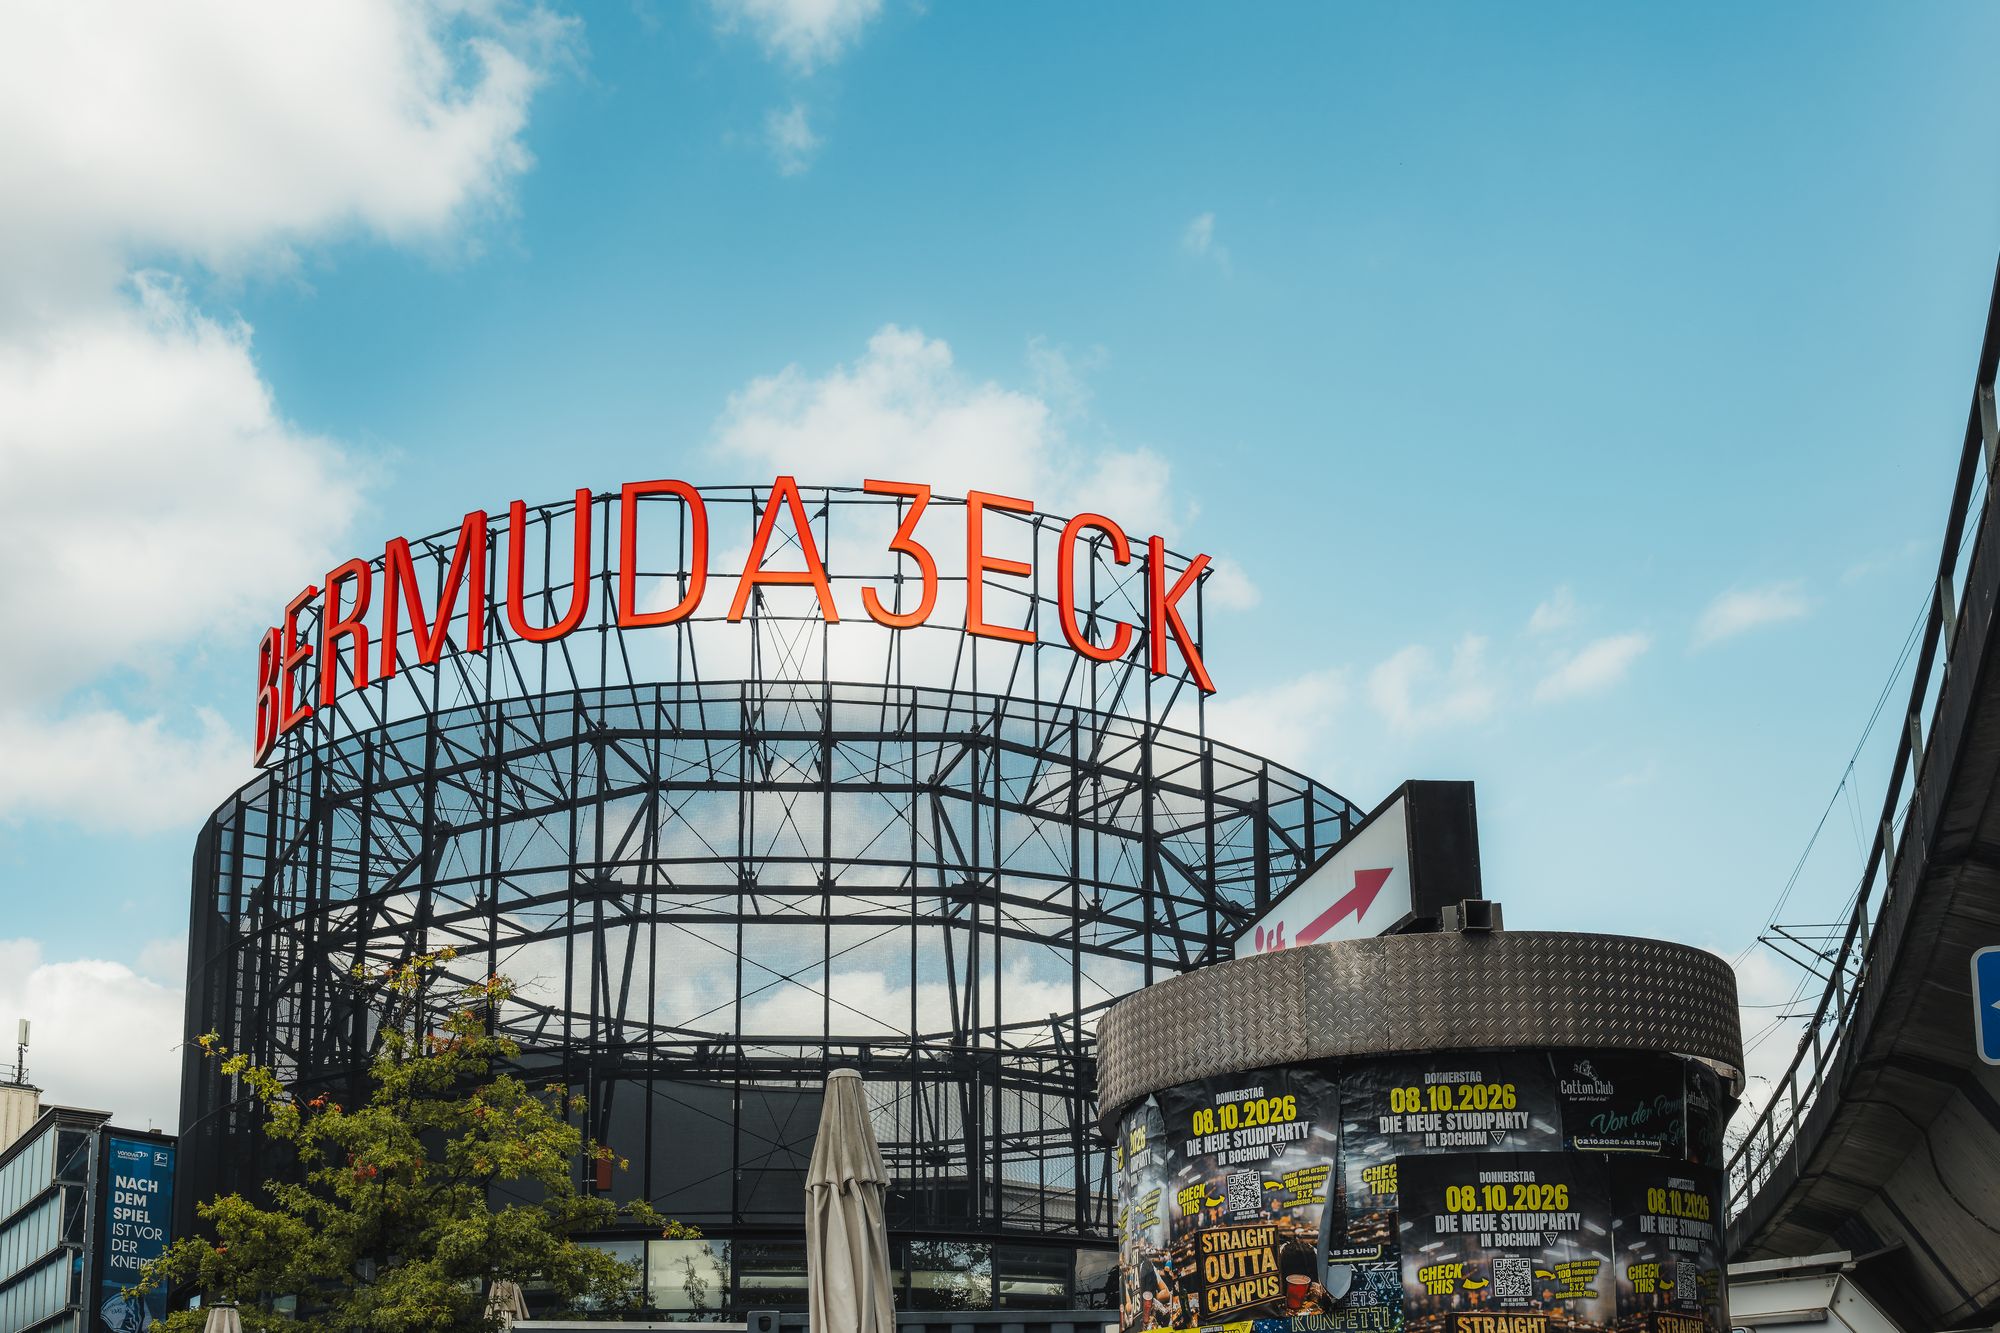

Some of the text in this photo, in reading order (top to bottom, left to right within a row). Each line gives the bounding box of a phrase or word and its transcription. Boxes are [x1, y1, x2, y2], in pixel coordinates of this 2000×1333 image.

[254, 476, 1217, 768] BERMUDA3ECK
[1424, 1071, 1482, 1084] DONNERSTAG
[1215, 1086, 1264, 1104] DONNERSTAG
[1561, 1079, 1614, 1095] Cotton Club
[1390, 1083, 1517, 1114] 08.10.2026
[1192, 1095, 1297, 1136] 08.10.2026
[1379, 1112, 1529, 1134] DIE NEUE STUDIPARTY
[1591, 1110, 1628, 1134] Von
[1631, 1101, 1653, 1125] der
[1186, 1121, 1309, 1157] DIE NEUE STUDIPARTY
[1425, 1133, 1436, 1147] IN
[1440, 1131, 1488, 1147] BOCHUM
[1218, 1152, 1226, 1166] IN
[1229, 1145, 1269, 1165] BOCHUM
[1362, 1163, 1397, 1183] CHEC
[1479, 1171, 1536, 1184] DONNERSTAG
[115, 1175, 158, 1193] NACH
[1285, 1178, 1298, 1188] 100
[1370, 1178, 1398, 1196] THIS
[114, 1191, 147, 1207] DEM
[1178, 1183, 1207, 1204] CHECK
[1445, 1183, 1569, 1213] 08.10.2026
[1182, 1199, 1200, 1216] THIS
[1647, 1187, 1709, 1220] 08.10.2026
[113, 1207, 151, 1223] SPIEL
[1435, 1213, 1580, 1233] DIE NEUE STUDIPARTY
[112, 1223, 163, 1241] IST VOR
[1640, 1215, 1656, 1233] DIE
[1658, 1216, 1678, 1235] NEUE
[111, 1238, 138, 1254] DER
[1202, 1227, 1276, 1253] STRAIGHT
[1480, 1233, 1492, 1247] IN
[1495, 1232, 1541, 1247] BOCHUM
[1205, 1247, 1278, 1283] OUTTA
[1418, 1263, 1464, 1283] CHECK
[1557, 1269, 1571, 1279] 100
[1627, 1263, 1660, 1281] CHECK
[1364, 1271, 1401, 1291] XXL
[1425, 1279, 1455, 1296] THIS
[1634, 1279, 1655, 1293] THIS
[1207, 1276, 1280, 1312] CAMPUS
[1291, 1306, 1390, 1332] KONFETTI
[1457, 1317, 1548, 1333] STRAIGHT
[1657, 1316, 1704, 1333] STRAIGHT
